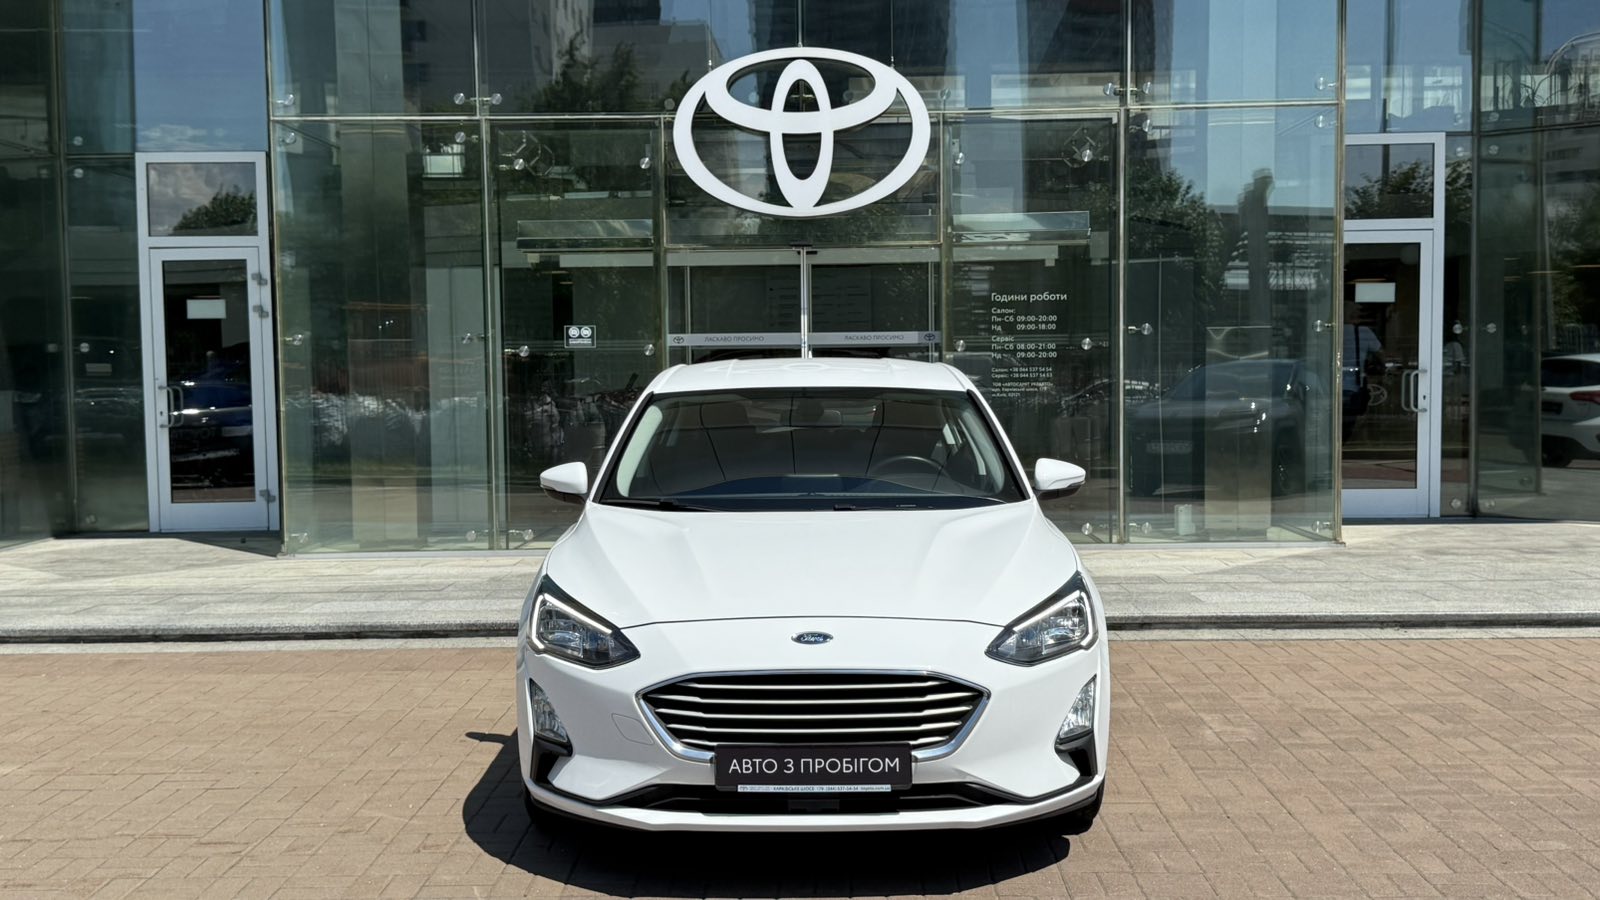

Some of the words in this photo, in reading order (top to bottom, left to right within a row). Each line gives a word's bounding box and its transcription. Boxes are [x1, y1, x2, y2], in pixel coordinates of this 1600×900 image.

[991, 292, 1027, 303] Години
[1029, 292, 1067, 303] роботи
[728, 758, 778, 774] АВТО
[800, 757, 899, 774] ПРОБІГОМ
